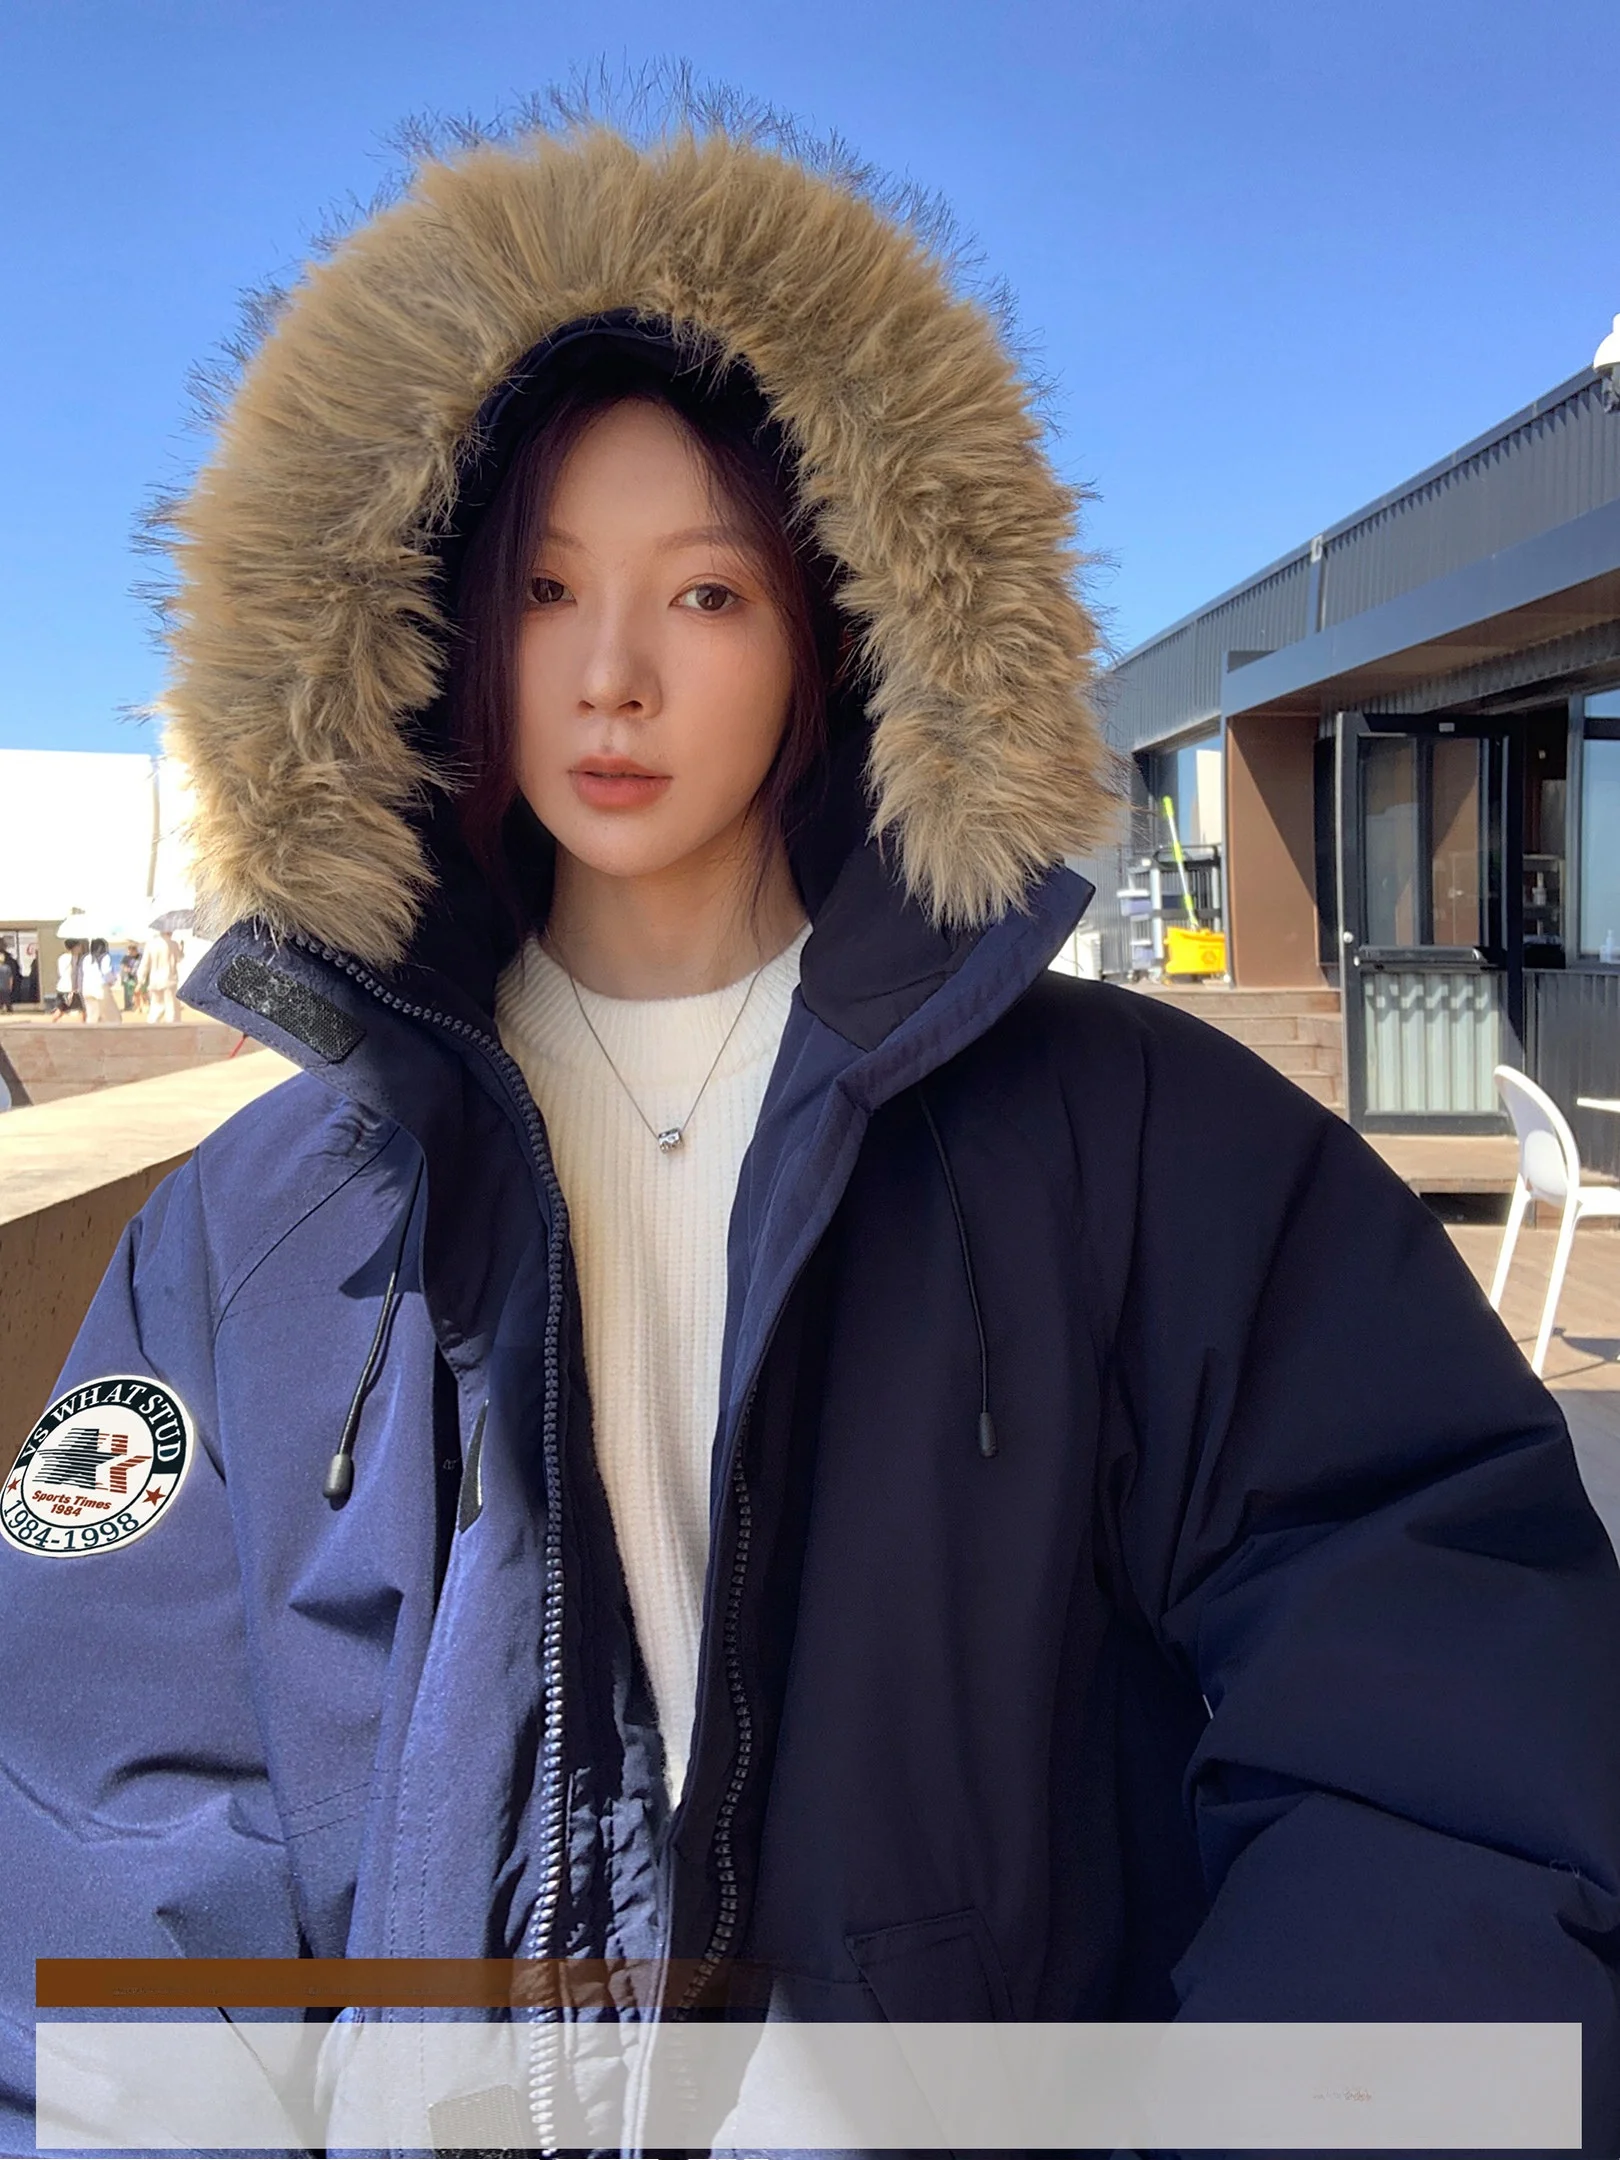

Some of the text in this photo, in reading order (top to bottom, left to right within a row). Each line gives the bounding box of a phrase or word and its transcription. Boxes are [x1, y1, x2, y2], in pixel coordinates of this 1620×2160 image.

[51, 1384, 147, 1423] WHAT
[139, 1395, 181, 1462] STUD
[32, 1490, 112, 1510] Sports Times
[50, 1504, 82, 1517] 1984
[4, 1500, 140, 1550] 1984-1998
